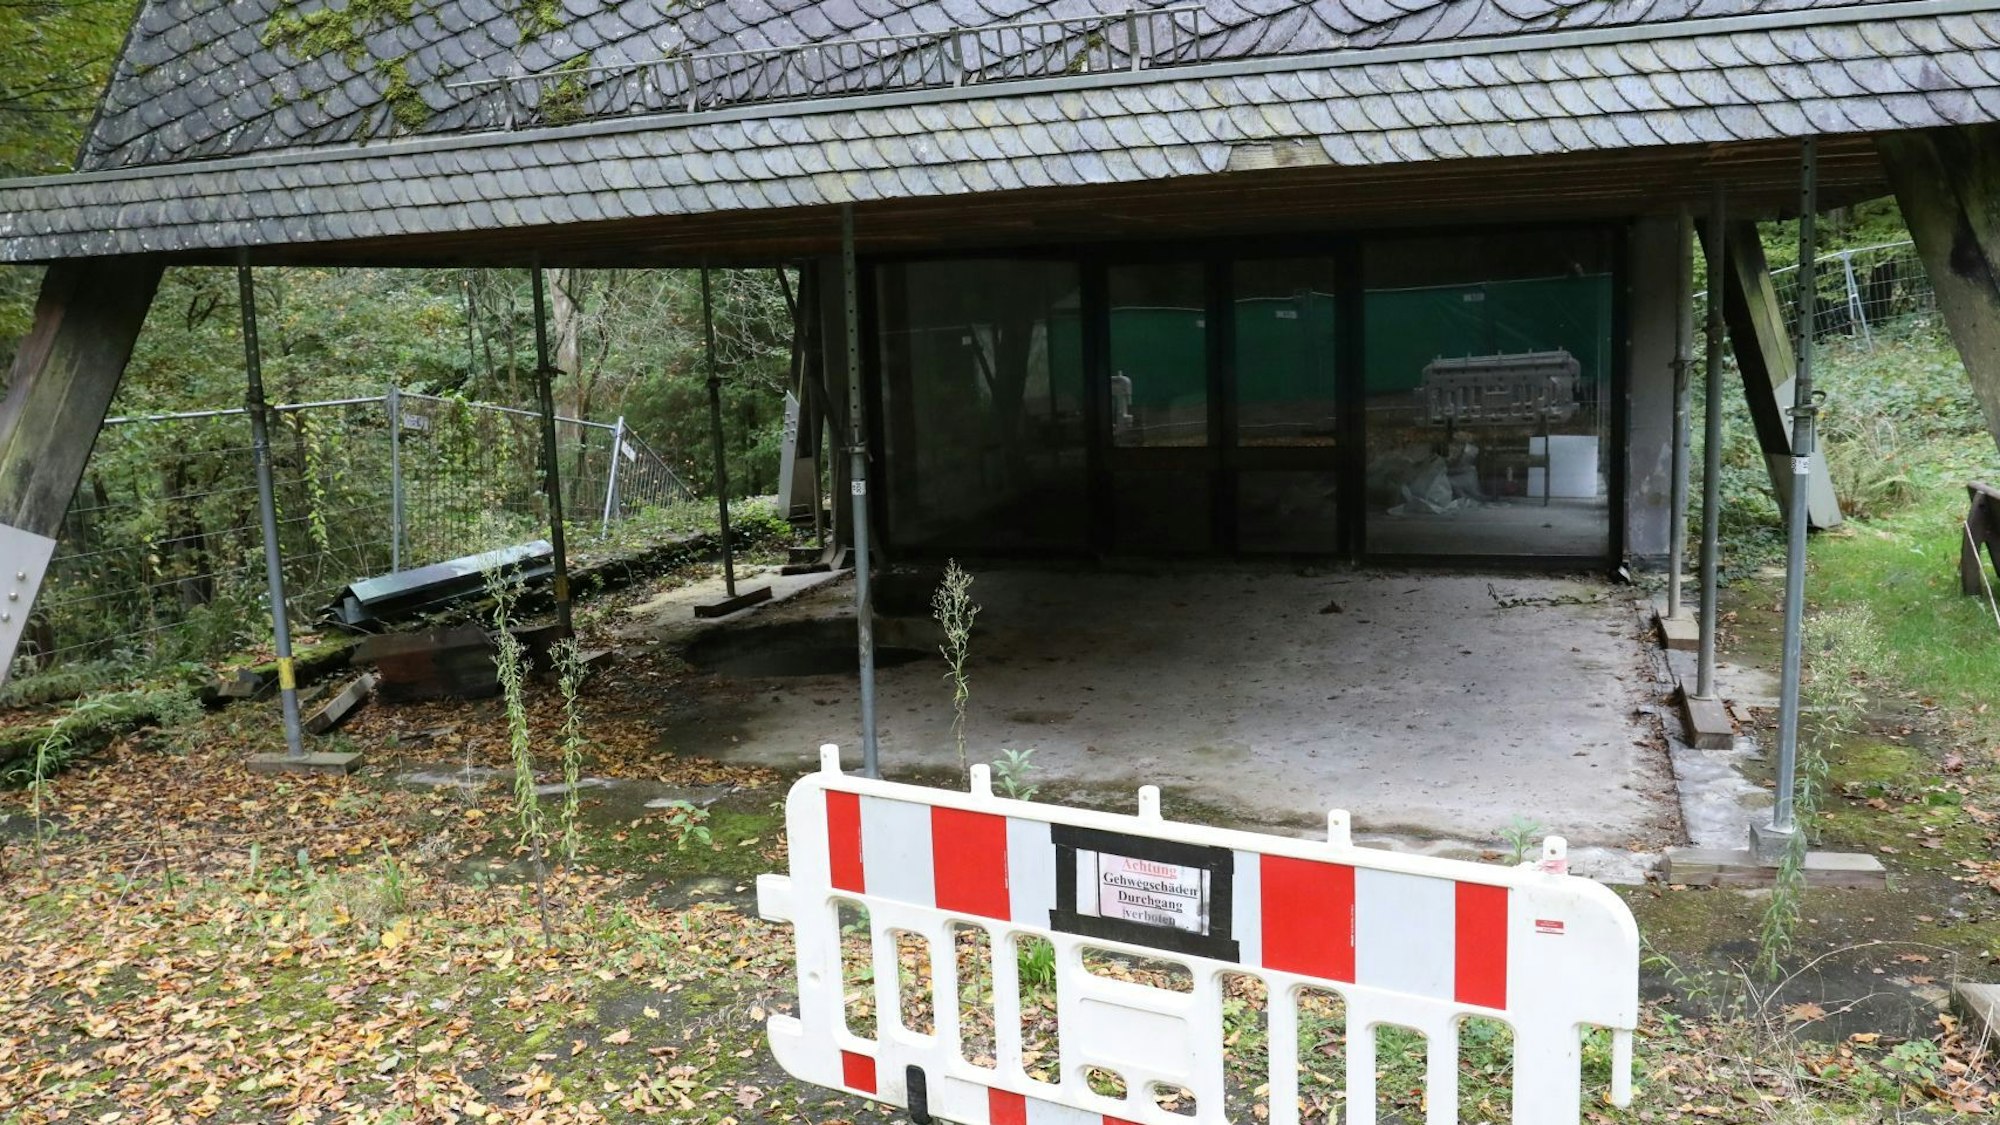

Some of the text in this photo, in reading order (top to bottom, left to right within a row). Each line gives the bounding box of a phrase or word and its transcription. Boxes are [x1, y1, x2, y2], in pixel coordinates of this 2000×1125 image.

[1123, 859, 1177, 879] Achtung
[1103, 872, 1198, 898] Gehwegschäden
[1118, 890, 1183, 914] Durchgang
